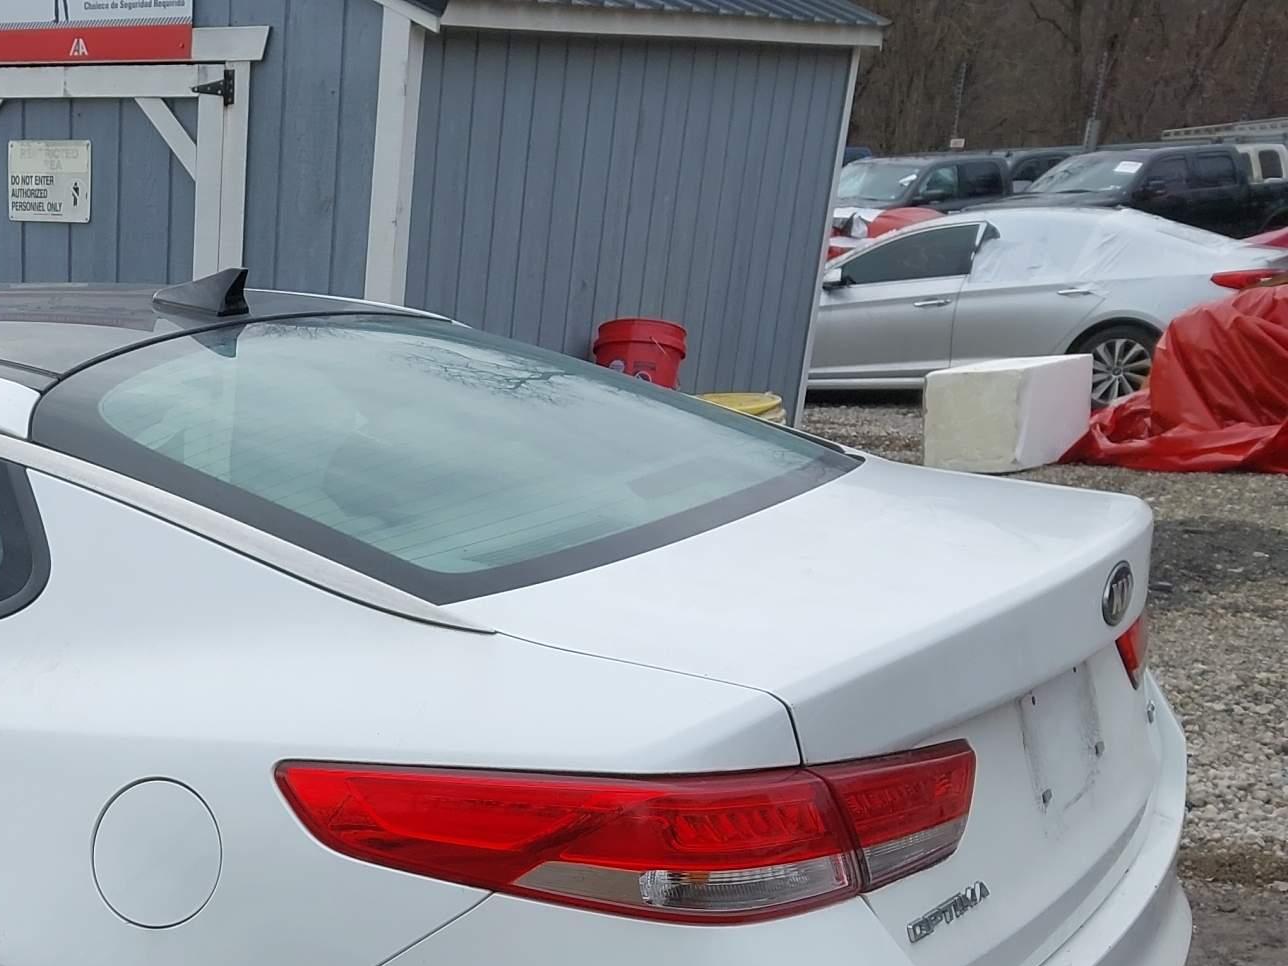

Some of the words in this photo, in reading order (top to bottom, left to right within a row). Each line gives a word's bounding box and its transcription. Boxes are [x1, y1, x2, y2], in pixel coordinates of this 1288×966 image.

[11, 175, 21, 186] DO
[21, 175, 34, 186] NOT
[34, 175, 54, 186] ENTER
[11, 188, 48, 199] AUTHORIZED
[11, 201, 46, 212] PERSONNEL
[46, 201, 63, 213] ONLY
[907, 880, 991, 944] OPTIMA
